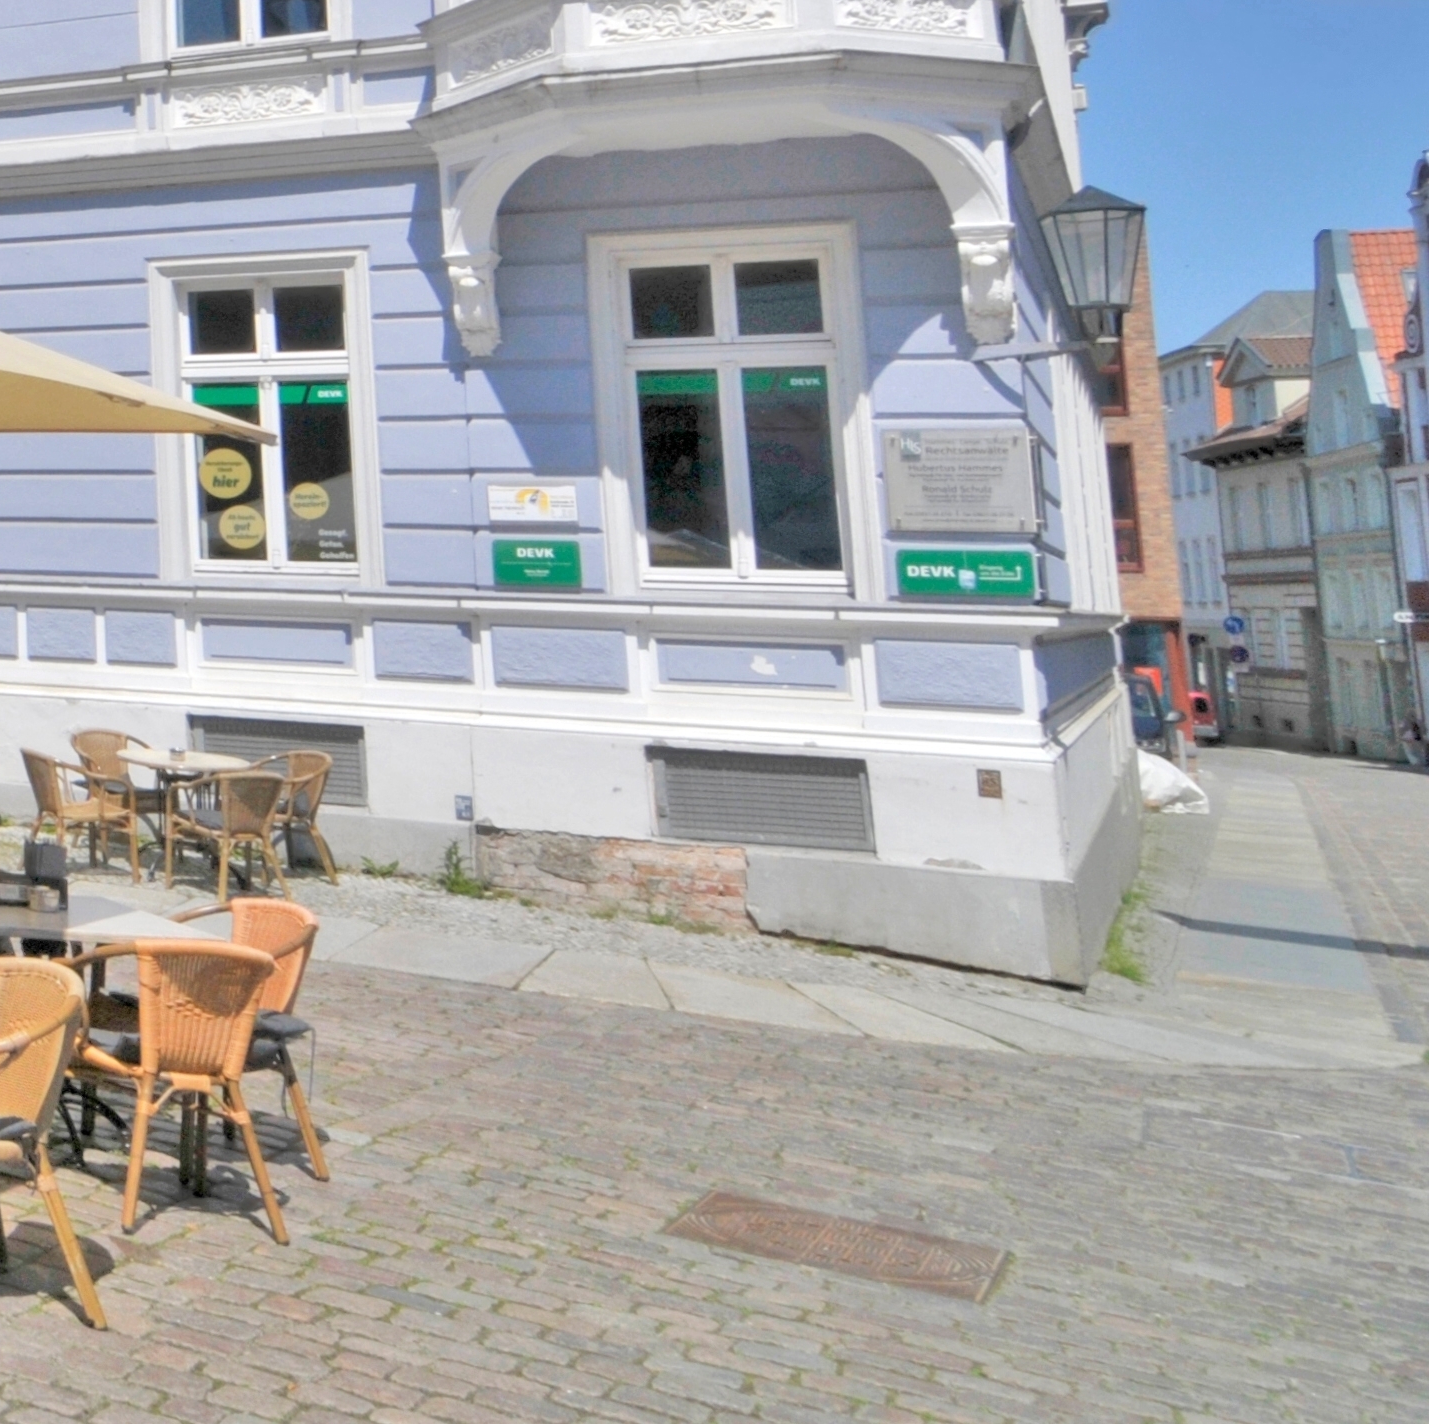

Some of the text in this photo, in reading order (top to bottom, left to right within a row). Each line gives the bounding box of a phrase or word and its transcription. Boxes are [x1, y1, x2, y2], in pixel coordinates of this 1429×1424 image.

[790, 377, 821, 386] DEVK
[908, 464, 1003, 473] Hubertus Hammes
[213, 476, 239, 488] hier
[922, 485, 992, 493] Ronald Schulz
[234, 522, 251, 533] gut
[516, 547, 555, 558] DEVK
[906, 565, 956, 578] DEVK
